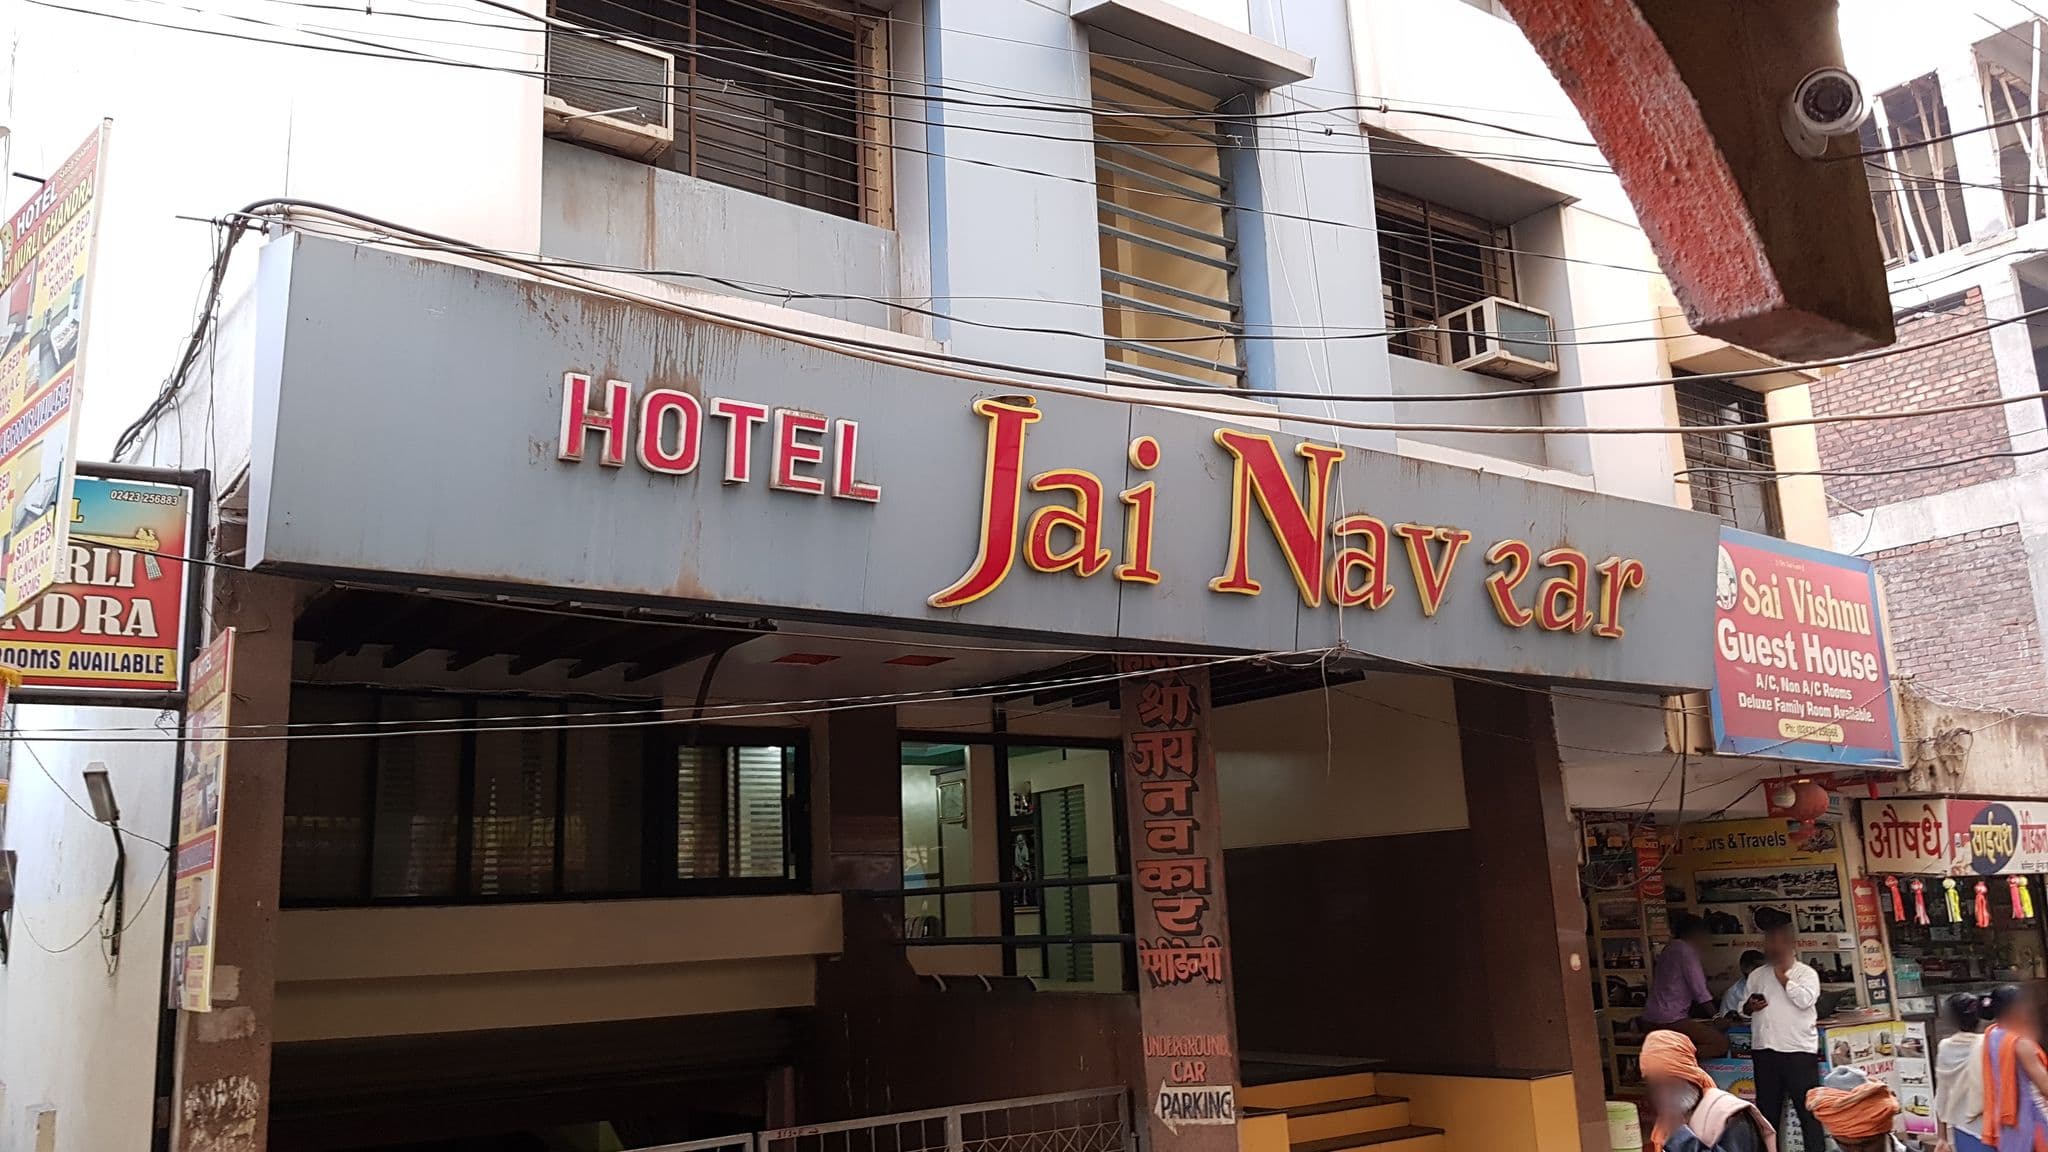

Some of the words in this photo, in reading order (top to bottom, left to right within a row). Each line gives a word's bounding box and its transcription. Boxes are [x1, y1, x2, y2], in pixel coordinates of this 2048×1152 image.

[13, 225, 42, 279] MURLI
[43, 170, 93, 246] CHANDRA
[17, 181, 58, 241] HOTEL
[110, 490, 140, 502] 02423
[142, 492, 178, 505] 256883
[557, 371, 881, 503] HOTEL
[927, 394, 1161, 609] Jai
[64, 545, 137, 588] RLI
[1740, 567, 1784, 620] Sai
[1786, 576, 1872, 636] Vishnu
[68, 650, 164, 674] AVAILABLE
[1717, 618, 1799, 671] Guest
[1802, 631, 1879, 682] House
[1738, 692, 1773, 711] Deluxe
[1774, 695, 1804, 717] Family
[1807, 700, 1832, 719] Room
[1781, 677, 1801, 695] Non
[1802, 680, 1822, 697] A/C
[1823, 683, 1853, 700] Rooms
[1131, 728, 1196, 778] जय
[1727, 832, 1738, 849] &
[1737, 830, 1787, 849] Travels
[1869, 803, 1942, 860] औषधे
[1146, 1034, 1231, 1057] UNDERGROUND
[1170, 1060, 1207, 1083] CAR
[1160, 1091, 1232, 1120] PARKING
